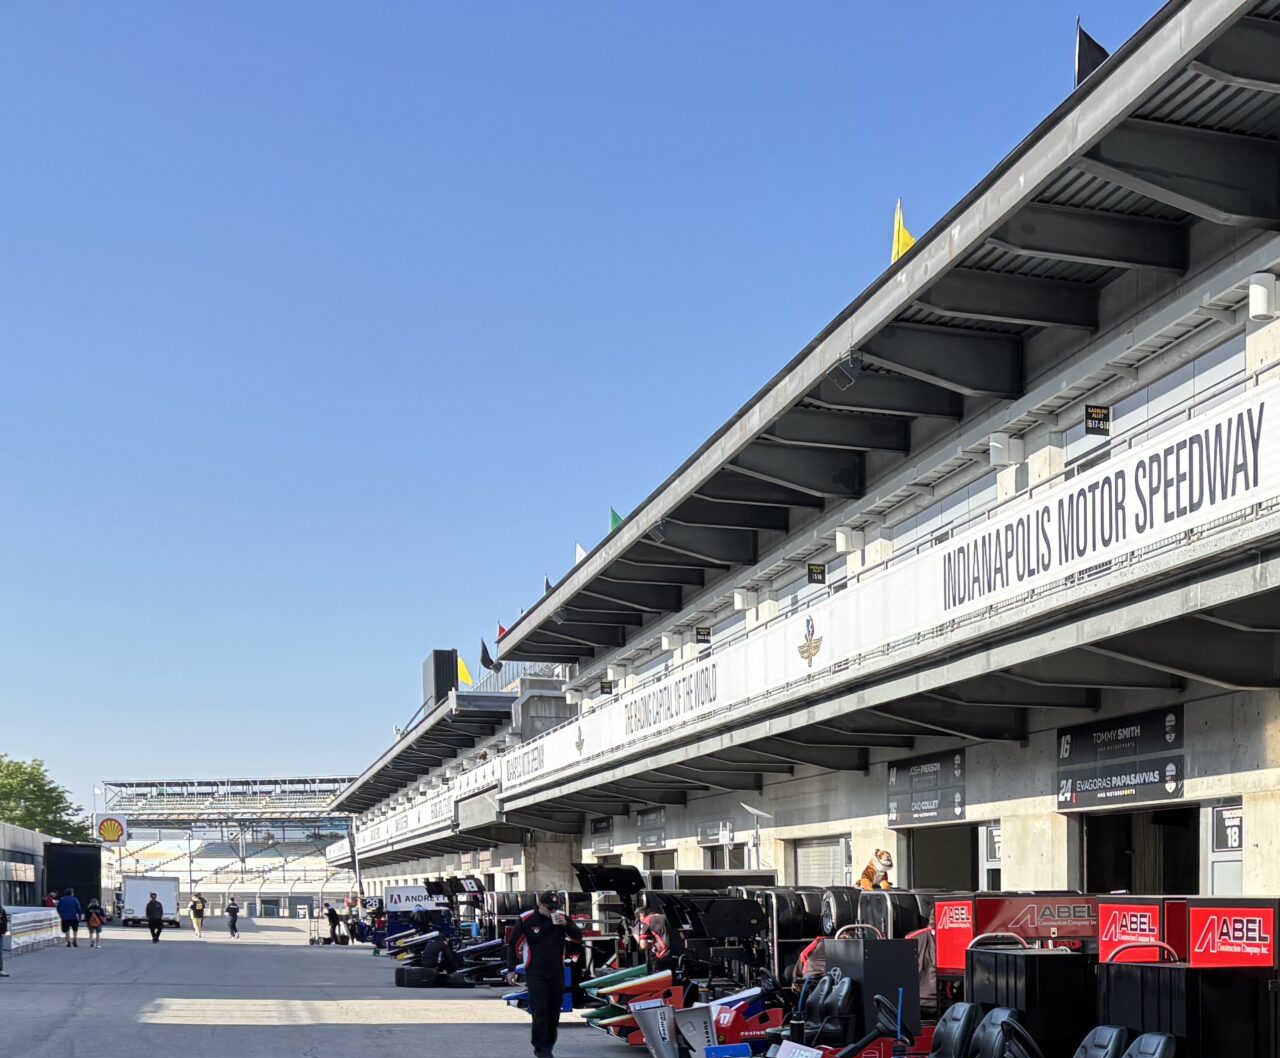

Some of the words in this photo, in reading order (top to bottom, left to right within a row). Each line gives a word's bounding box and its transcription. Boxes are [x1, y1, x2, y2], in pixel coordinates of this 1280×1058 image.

[943, 505, 1052, 611] INDIANAPOLIS
[1058, 469, 1127, 566] MOTOR
[1134, 401, 1265, 534] SPEEDWAY
[1093, 730, 1118, 745] TOMMY
[1118, 725, 1140, 740] SMITH
[1076, 777, 1112, 792] EVAGORAS
[1112, 771, 1159, 787] PAPASAVVAS
[1226, 826, 1239, 848] 18
[461, 879, 479, 891] 18
[365, 899, 379, 908] 28
[1038, 905, 1096, 920] ABEL
[949, 906, 971, 922] ABEL
[1119, 912, 1157, 935] ABEL
[1217, 917, 1270, 944] ABEL
